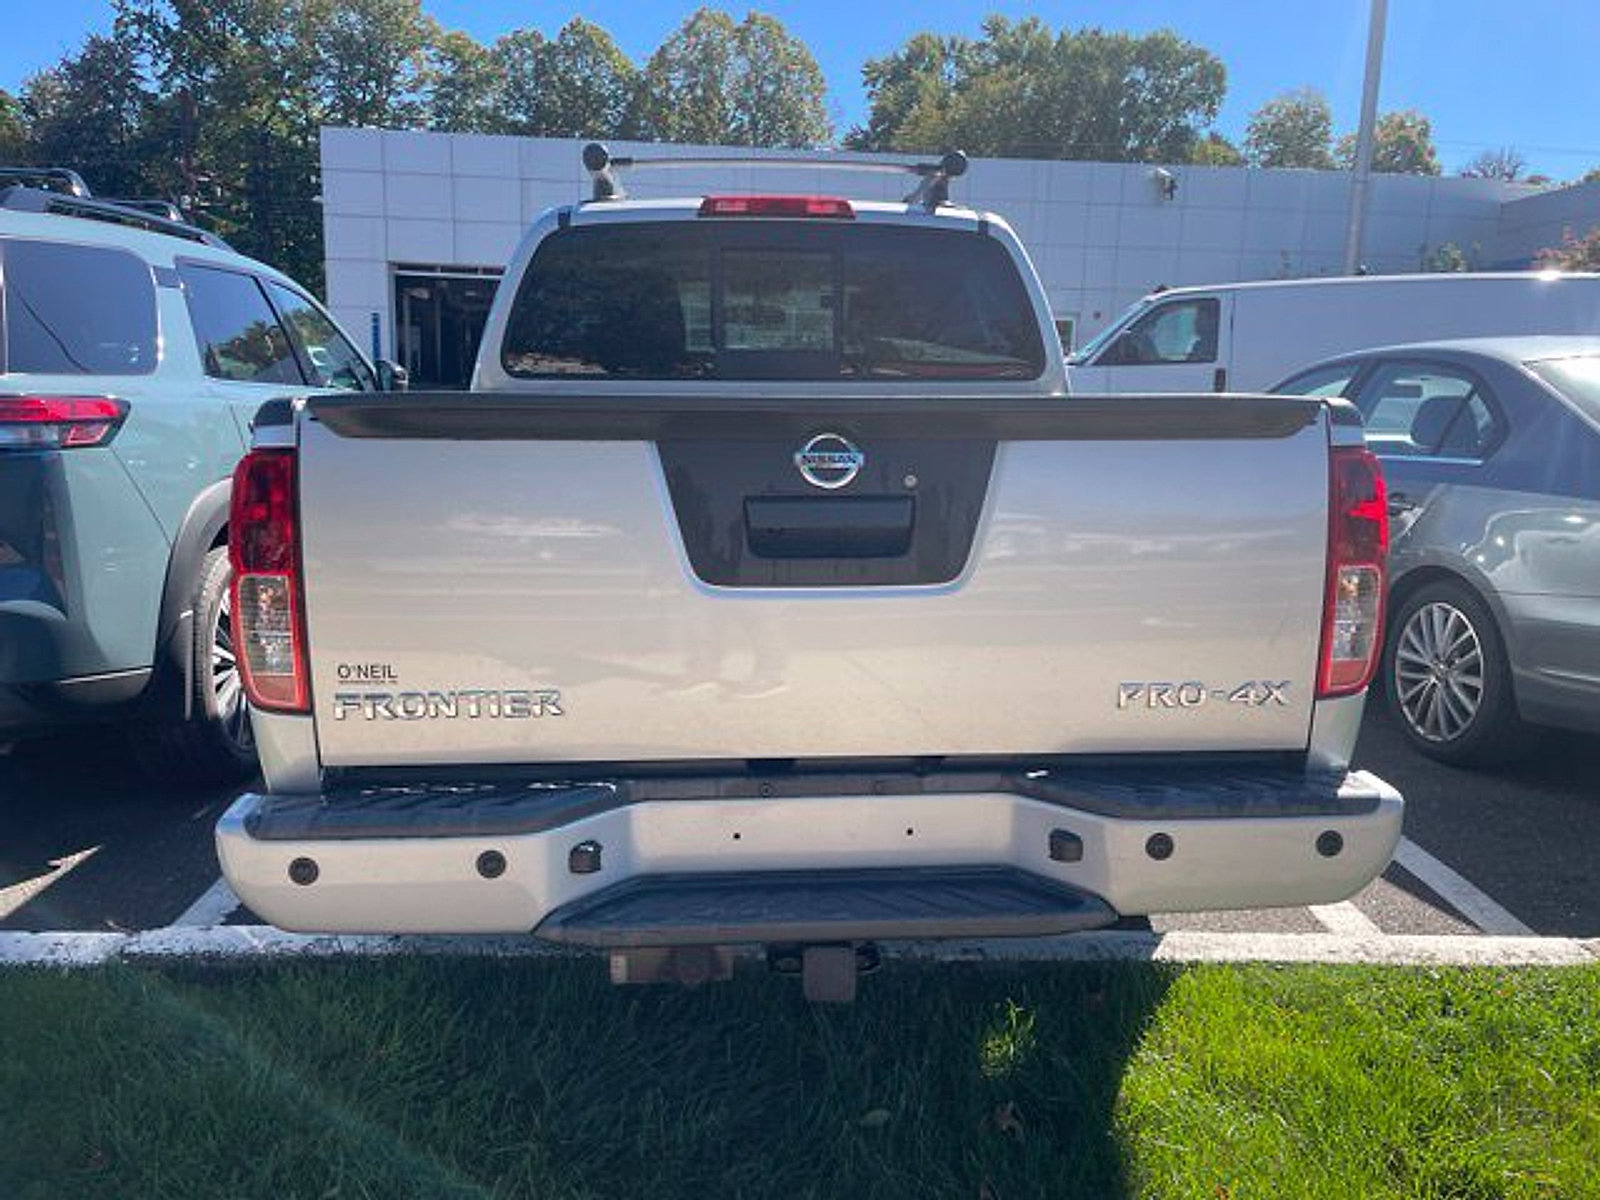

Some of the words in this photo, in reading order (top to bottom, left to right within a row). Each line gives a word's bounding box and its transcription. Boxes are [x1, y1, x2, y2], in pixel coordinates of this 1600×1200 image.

[799, 452, 860, 467] NISSAN
[337, 665, 398, 679] O'NEIL
[1118, 680, 1291, 708] PRO-4X
[334, 690, 563, 720] FRONTIER
